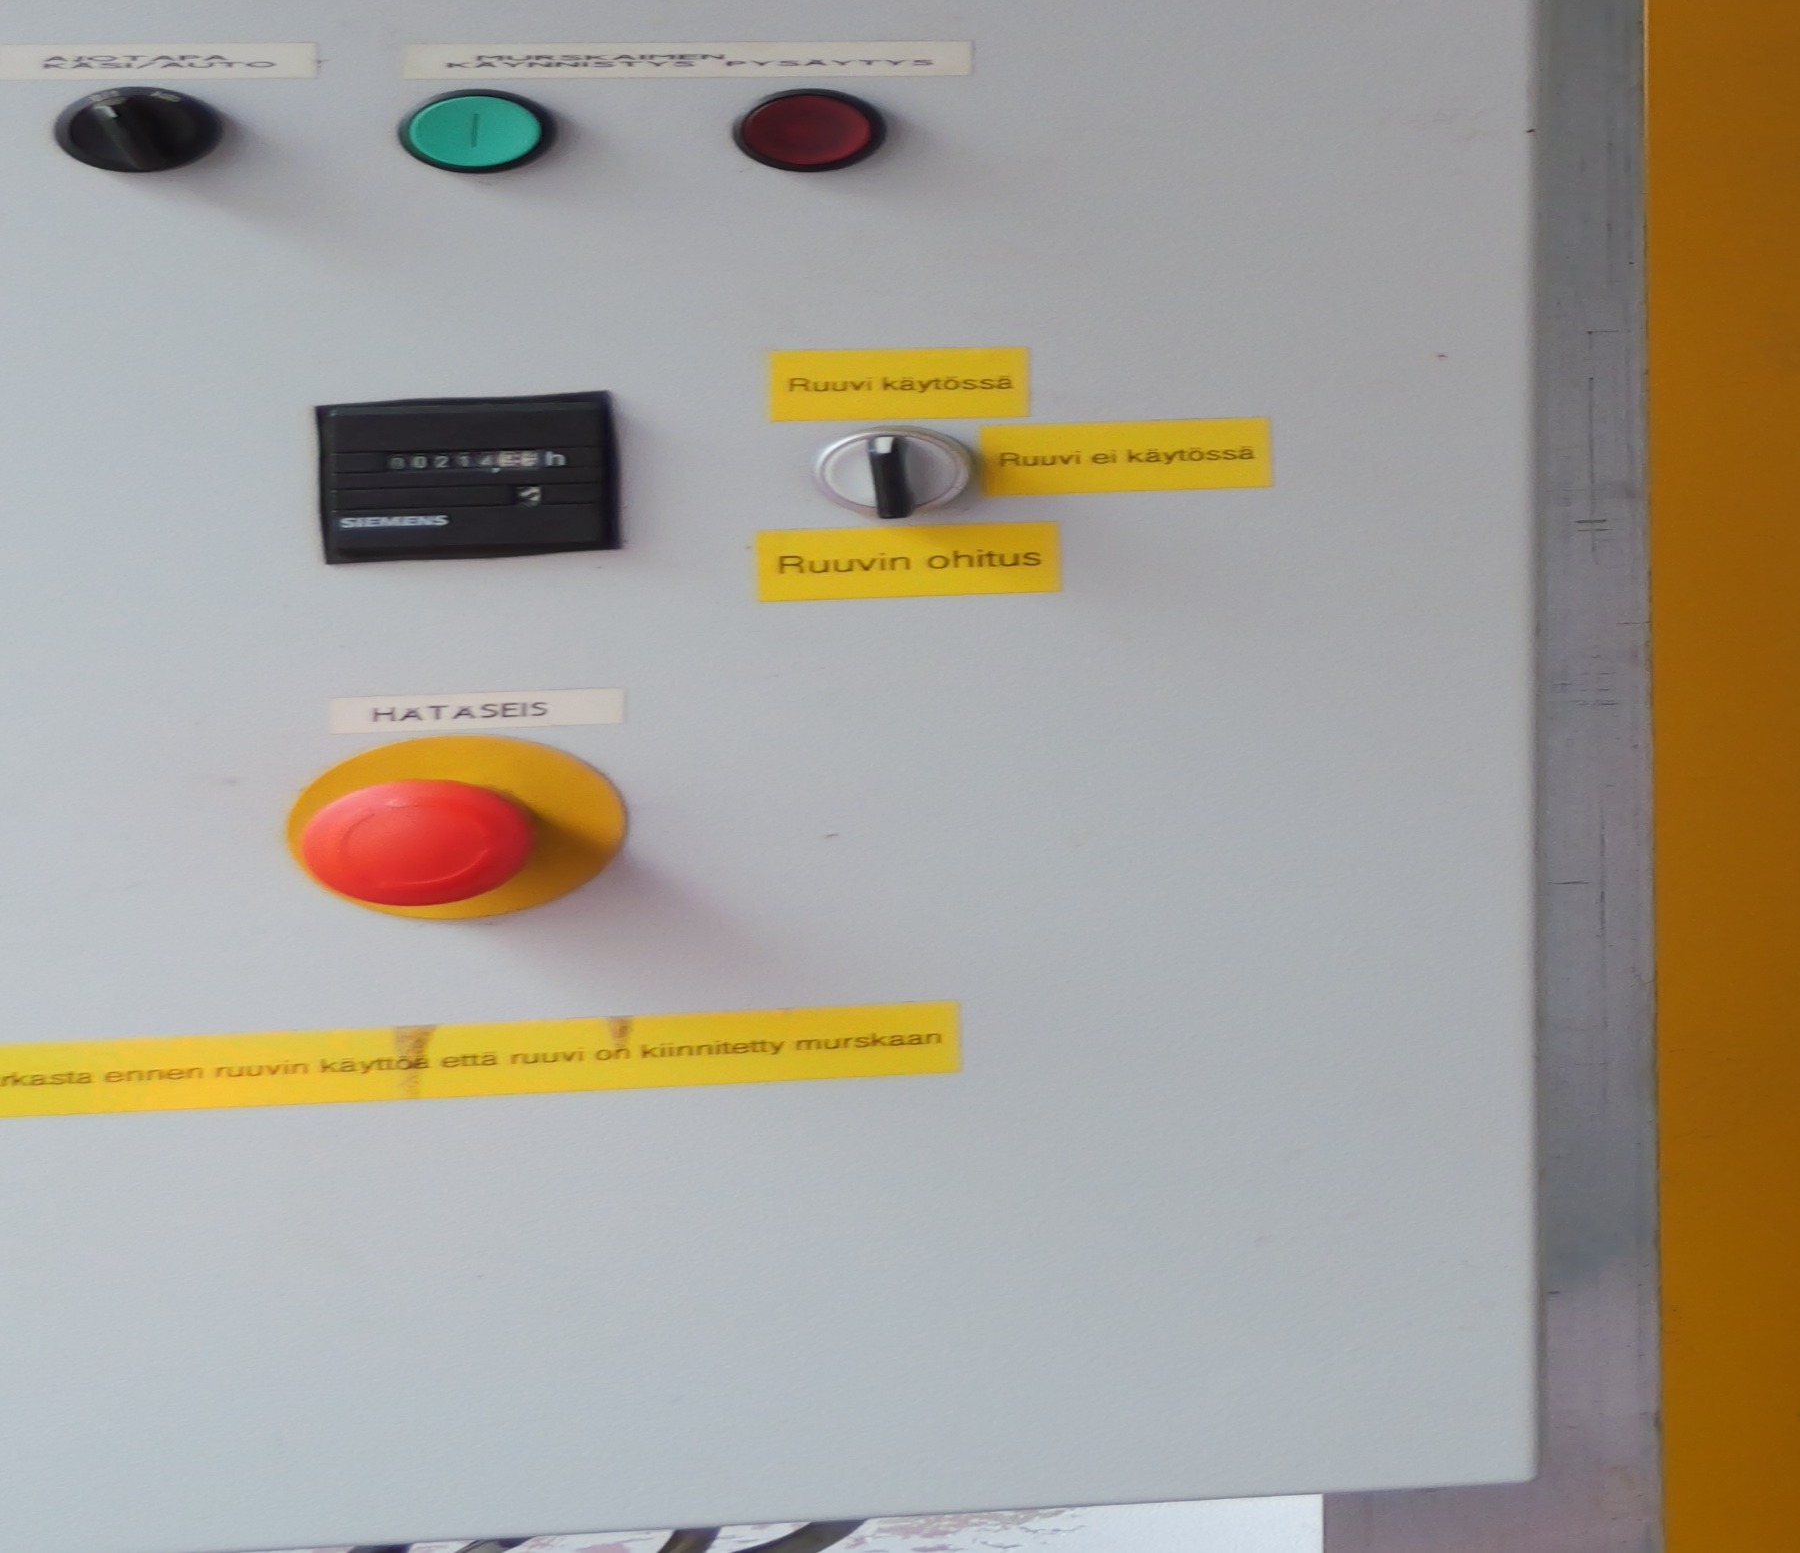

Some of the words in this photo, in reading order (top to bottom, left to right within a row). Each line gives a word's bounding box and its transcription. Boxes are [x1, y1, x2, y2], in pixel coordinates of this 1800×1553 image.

[46, 54, 229, 62] AJOTAPA
[476, 53, 727, 61] MURSKAIMEN
[788, 376, 874, 393] Ruuvi
[881, 374, 1015, 393] käytössä
[545, 450, 566, 467] h
[1000, 451, 1082, 467] Ruuvi
[1092, 450, 1119, 464] ei
[1126, 447, 1257, 465] käytössä
[340, 515, 450, 529] SIEMENS
[777, 553, 912, 575] Ruuvin
[926, 549, 1043, 571] ohitus
[371, 701, 550, 723] HÄTÄSEIS
[106, 1066, 206, 1084] ennen
[216, 1060, 312, 1079] ruuvin
[443, 1051, 498, 1067] että
[510, 1047, 585, 1065] ruuvi
[594, 1047, 632, 1062] on
[639, 1040, 787, 1059] kiinnitetty
[795, 1032, 944, 1052] murskaan
